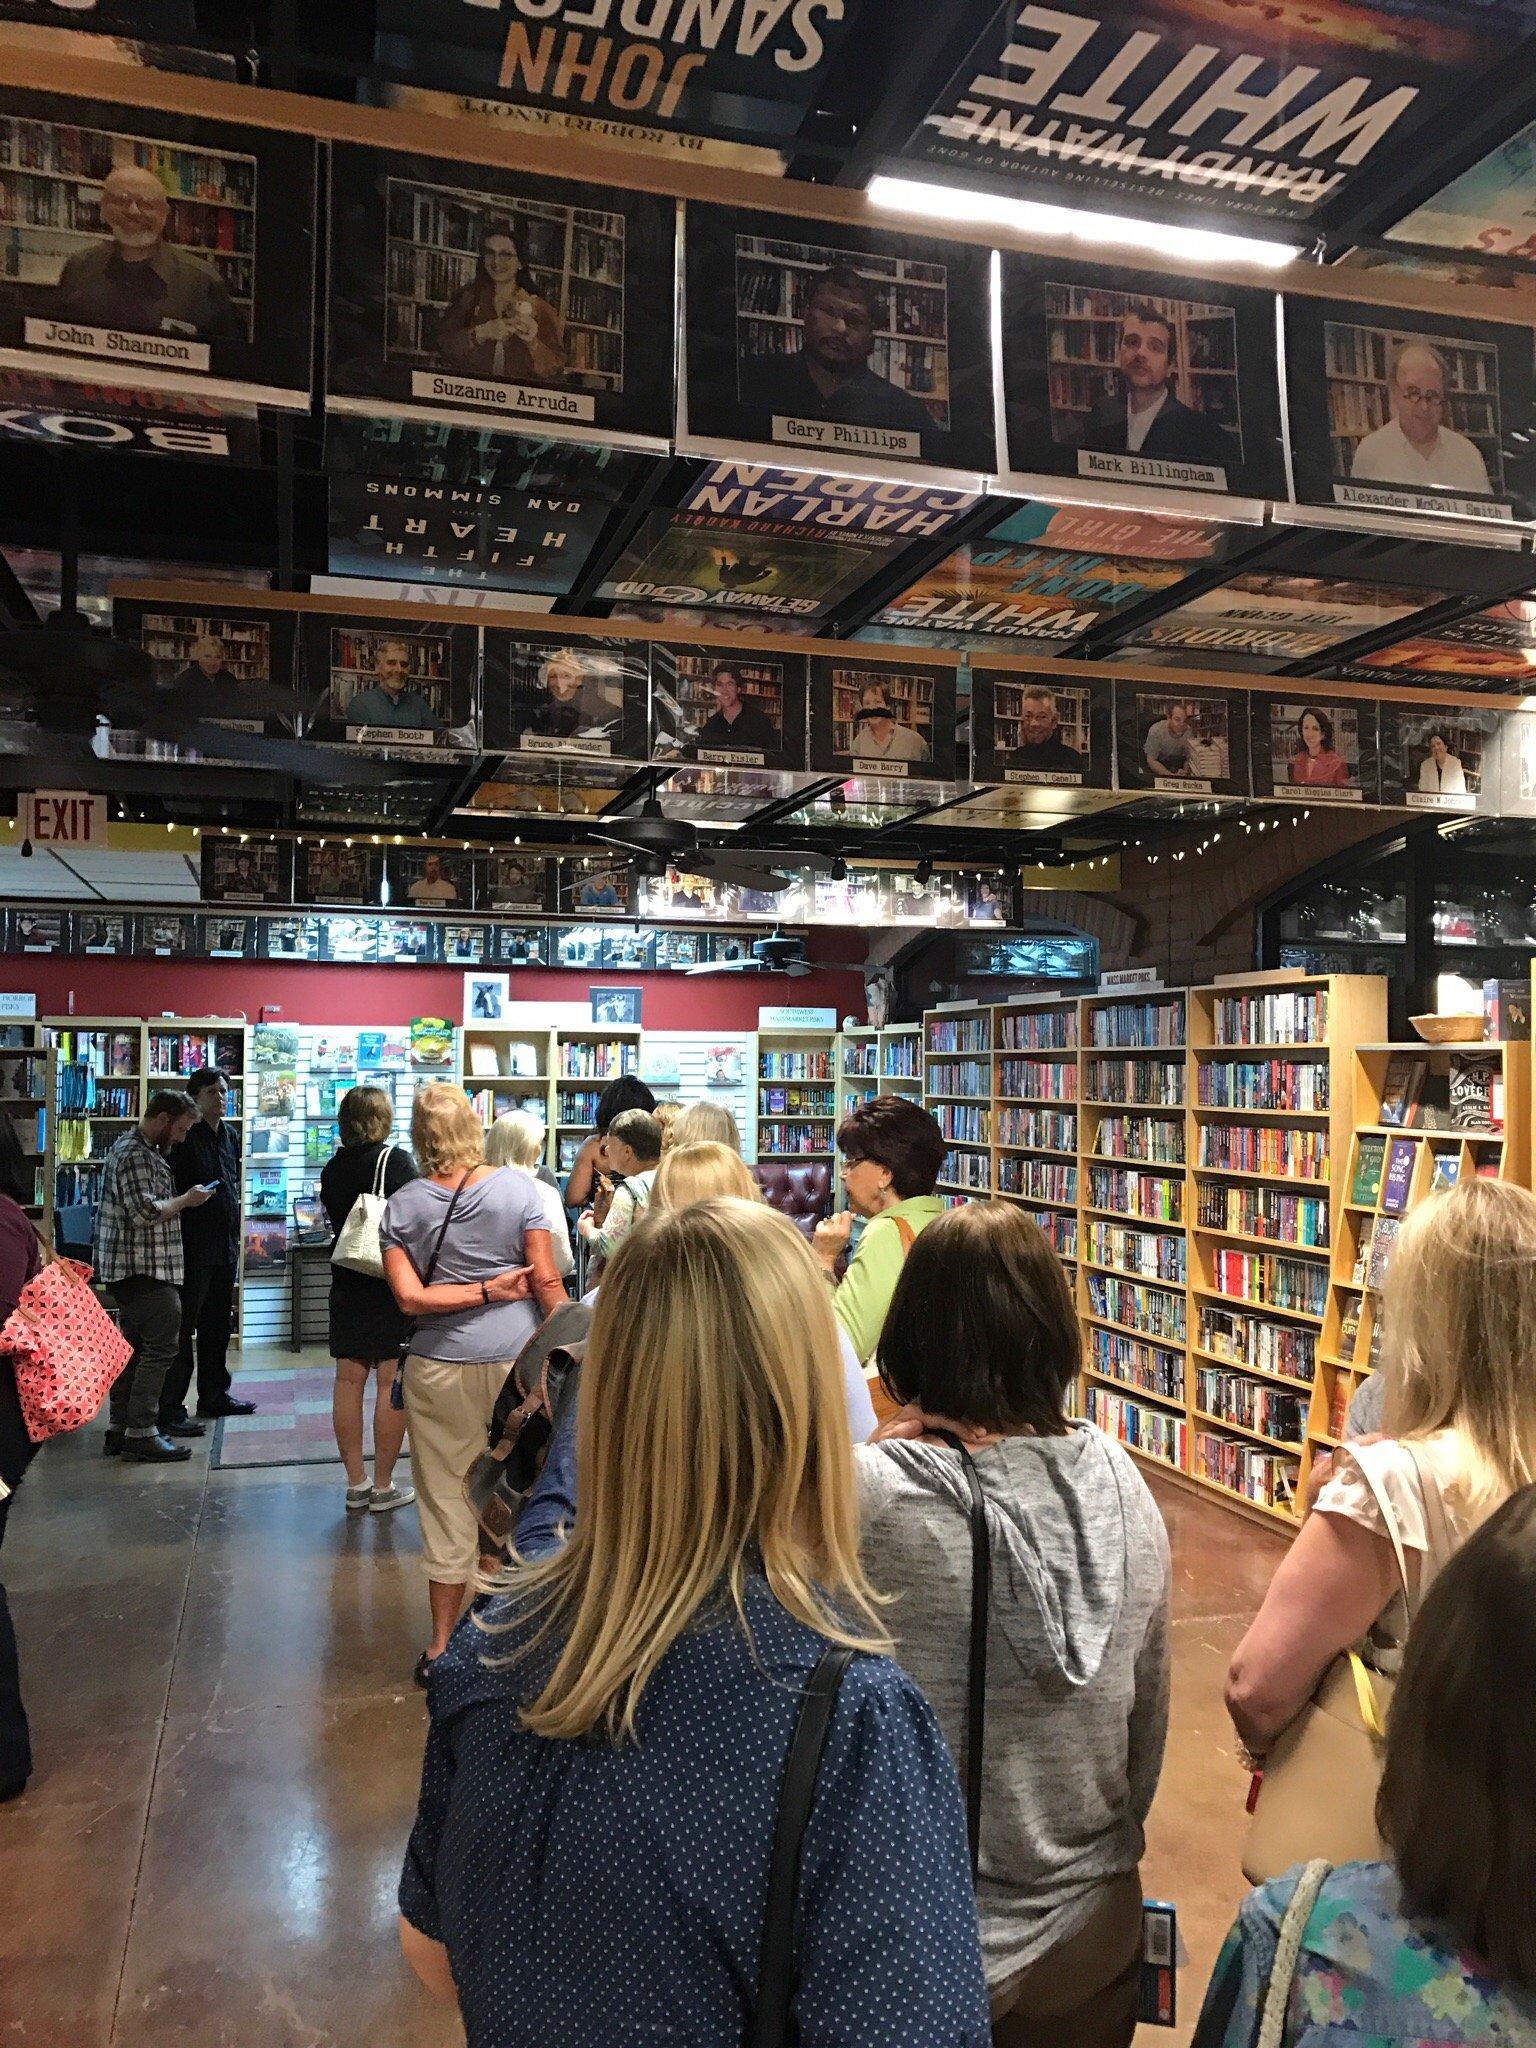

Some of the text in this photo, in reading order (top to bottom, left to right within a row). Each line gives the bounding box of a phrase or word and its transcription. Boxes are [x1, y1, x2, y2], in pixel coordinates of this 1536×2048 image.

[497, 21, 706, 117] JOHN
[969, 4, 1419, 165] WHITE
[558, 114, 664, 143] ROBERT
[936, 100, 1346, 203] RANDY WAYNE
[45, 324, 190, 359] John Shannon
[433, 378, 578, 413] Suzanne Arruda
[787, 420, 907, 449] Gary Phillips
[1087, 454, 1214, 483] Mark Billingham
[366, 482, 581, 513] DAN SIMMONS
[688, 486, 954, 535] HARLAN
[1342, 486, 1501, 518] Alexander McCall Smith
[363, 514, 567, 548] HEART
[1057, 516, 1223, 547] THE GIRL
[385, 542, 535, 567] FIFTH
[421, 566, 488, 580] THE
[709, 590, 821, 613] GETAWAY
[898, 595, 1099, 632] WHITE
[882, 616, 1079, 640] RANDY WAYNE
[1136, 625, 1343, 653] GLORIOUS
[397, 729, 425, 741] Booth
[703, 753, 727, 764] Barry
[859, 761, 903, 773] Dave Barry
[1010, 771, 1038, 782] Stephen
[1163, 780, 1180, 790] Greg
[1282, 787, 1302, 797] Carol
[34, 799, 94, 840] EXIT
